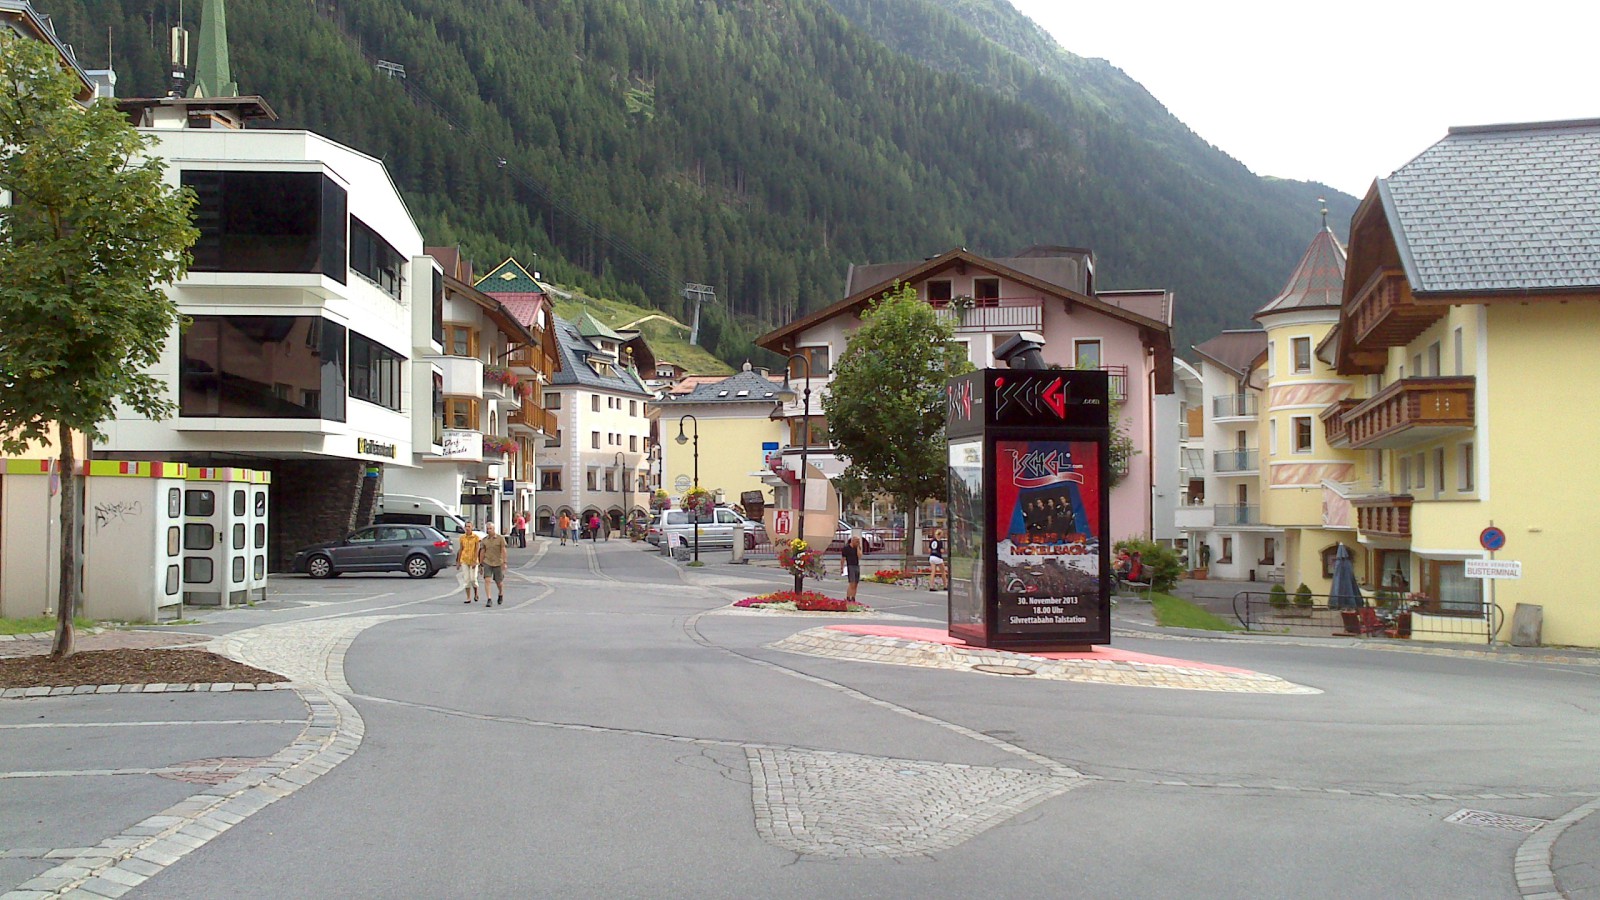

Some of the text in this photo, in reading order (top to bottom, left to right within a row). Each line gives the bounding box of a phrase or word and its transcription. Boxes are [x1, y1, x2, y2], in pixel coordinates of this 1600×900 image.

[1010, 545, 1088, 556] NICKELBACK
[1467, 567, 1519, 577] BUSTERMINAL
[1017, 596, 1078, 605] 30. November 2013
[1033, 606, 1064, 614] 18.00 Uhr
[1009, 615, 1087, 624] Silvrettabahn Talstation
